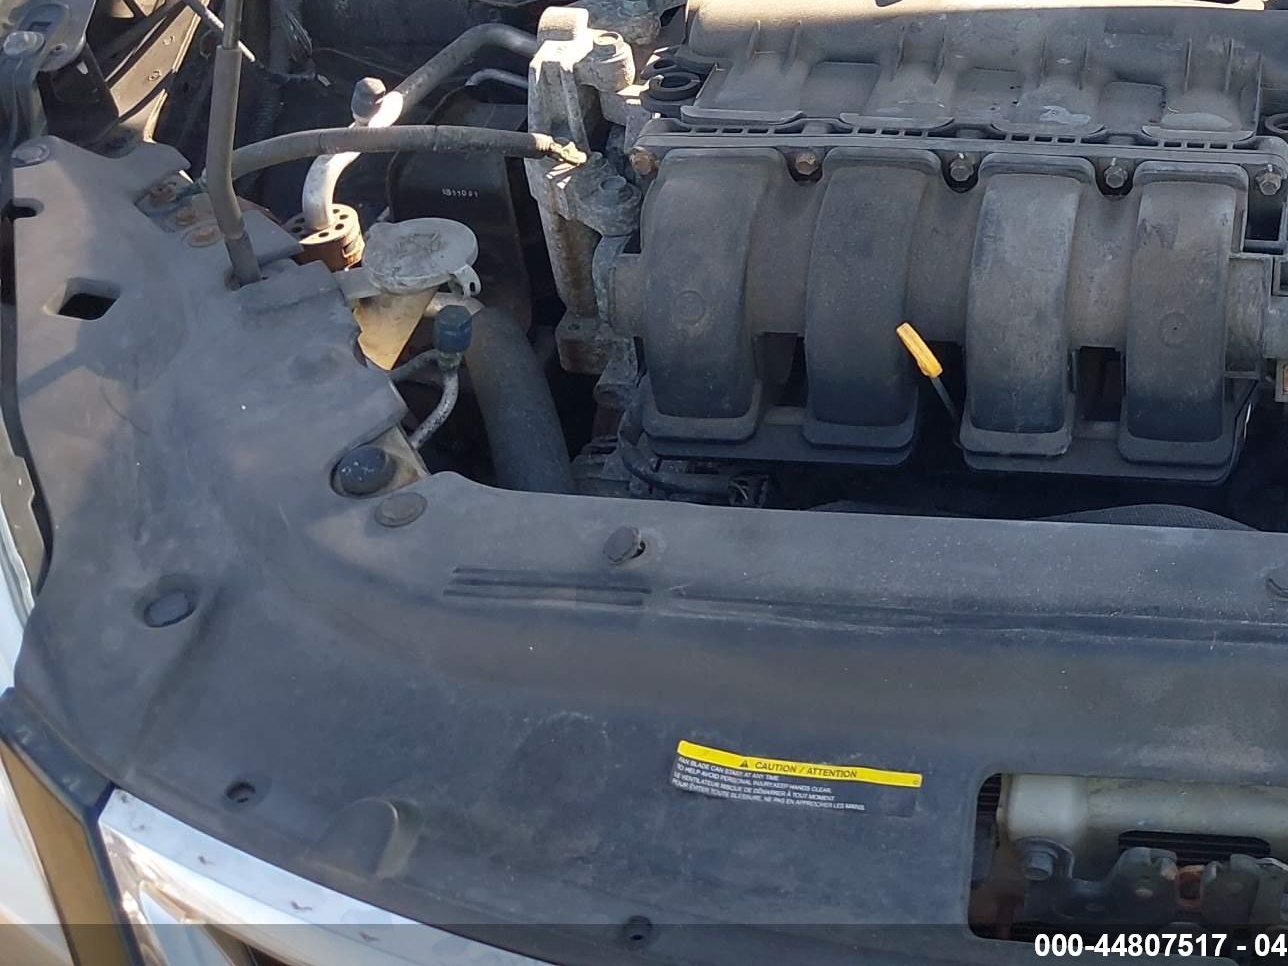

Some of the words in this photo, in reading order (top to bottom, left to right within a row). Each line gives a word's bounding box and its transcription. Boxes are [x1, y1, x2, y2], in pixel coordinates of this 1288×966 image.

[690, 760, 709, 771] BLADE
[711, 765, 724, 773] CAN
[755, 761, 796, 773] CAUTION
[807, 767, 857, 778] ATTENTION
[672, 778, 688, 788] POUR
[682, 773, 719, 787] VENTILATEUR
[685, 767, 700, 775] HELP
[701, 770, 719, 779] AVOID
[720, 773, 752, 786] PERSONAL
